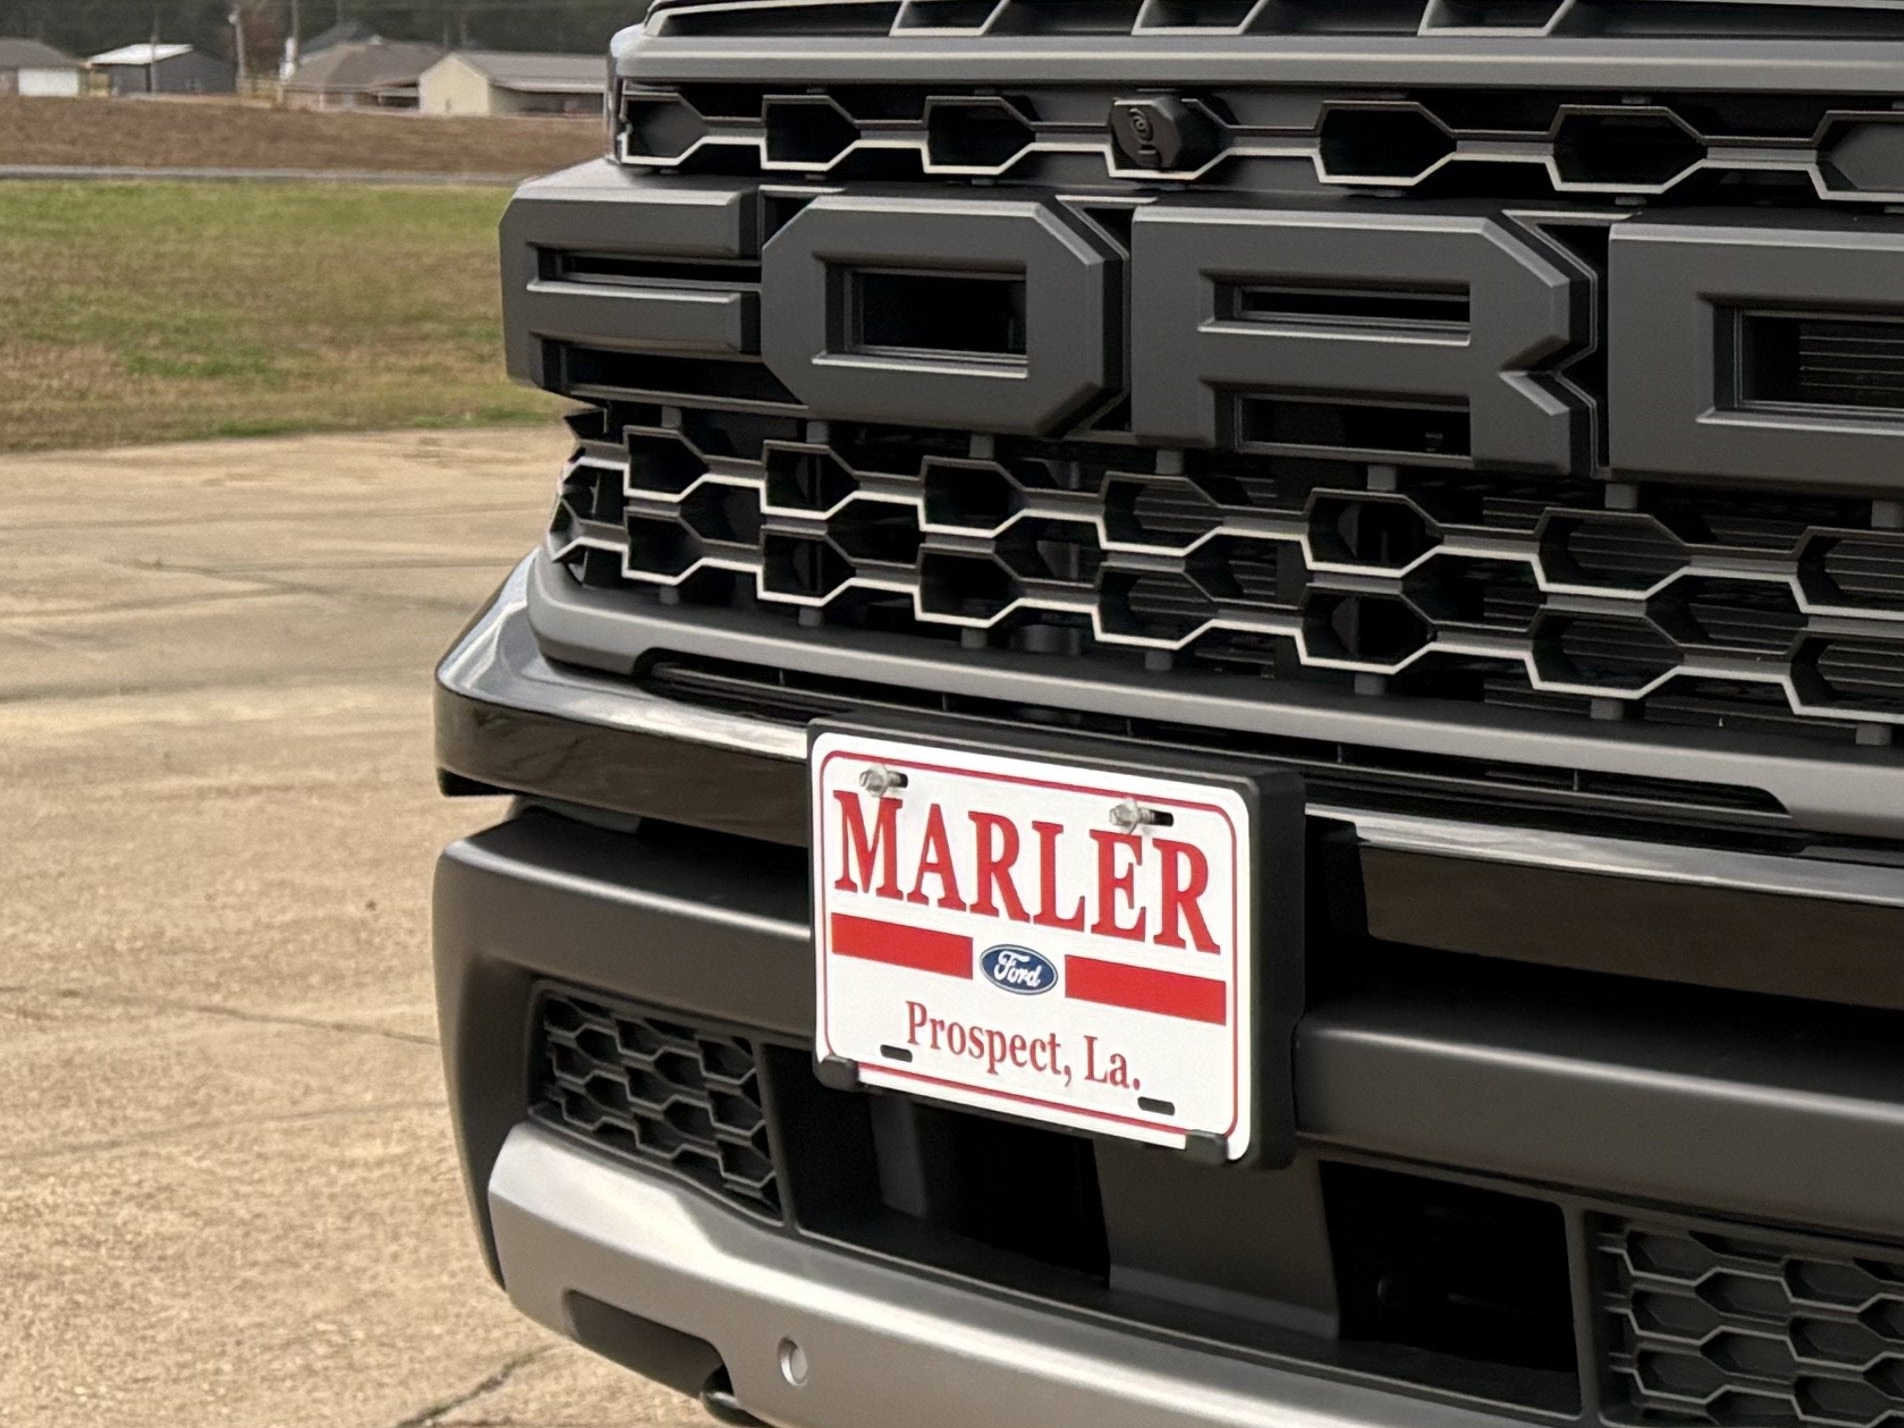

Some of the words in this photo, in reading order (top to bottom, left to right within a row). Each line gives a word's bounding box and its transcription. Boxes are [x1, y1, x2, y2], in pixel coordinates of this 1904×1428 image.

[833, 789, 1221, 955] MARLER
[993, 950, 1042, 988] Ford
[906, 1001, 1073, 1088] Prospect,
[1084, 1035, 1141, 1090] La.
